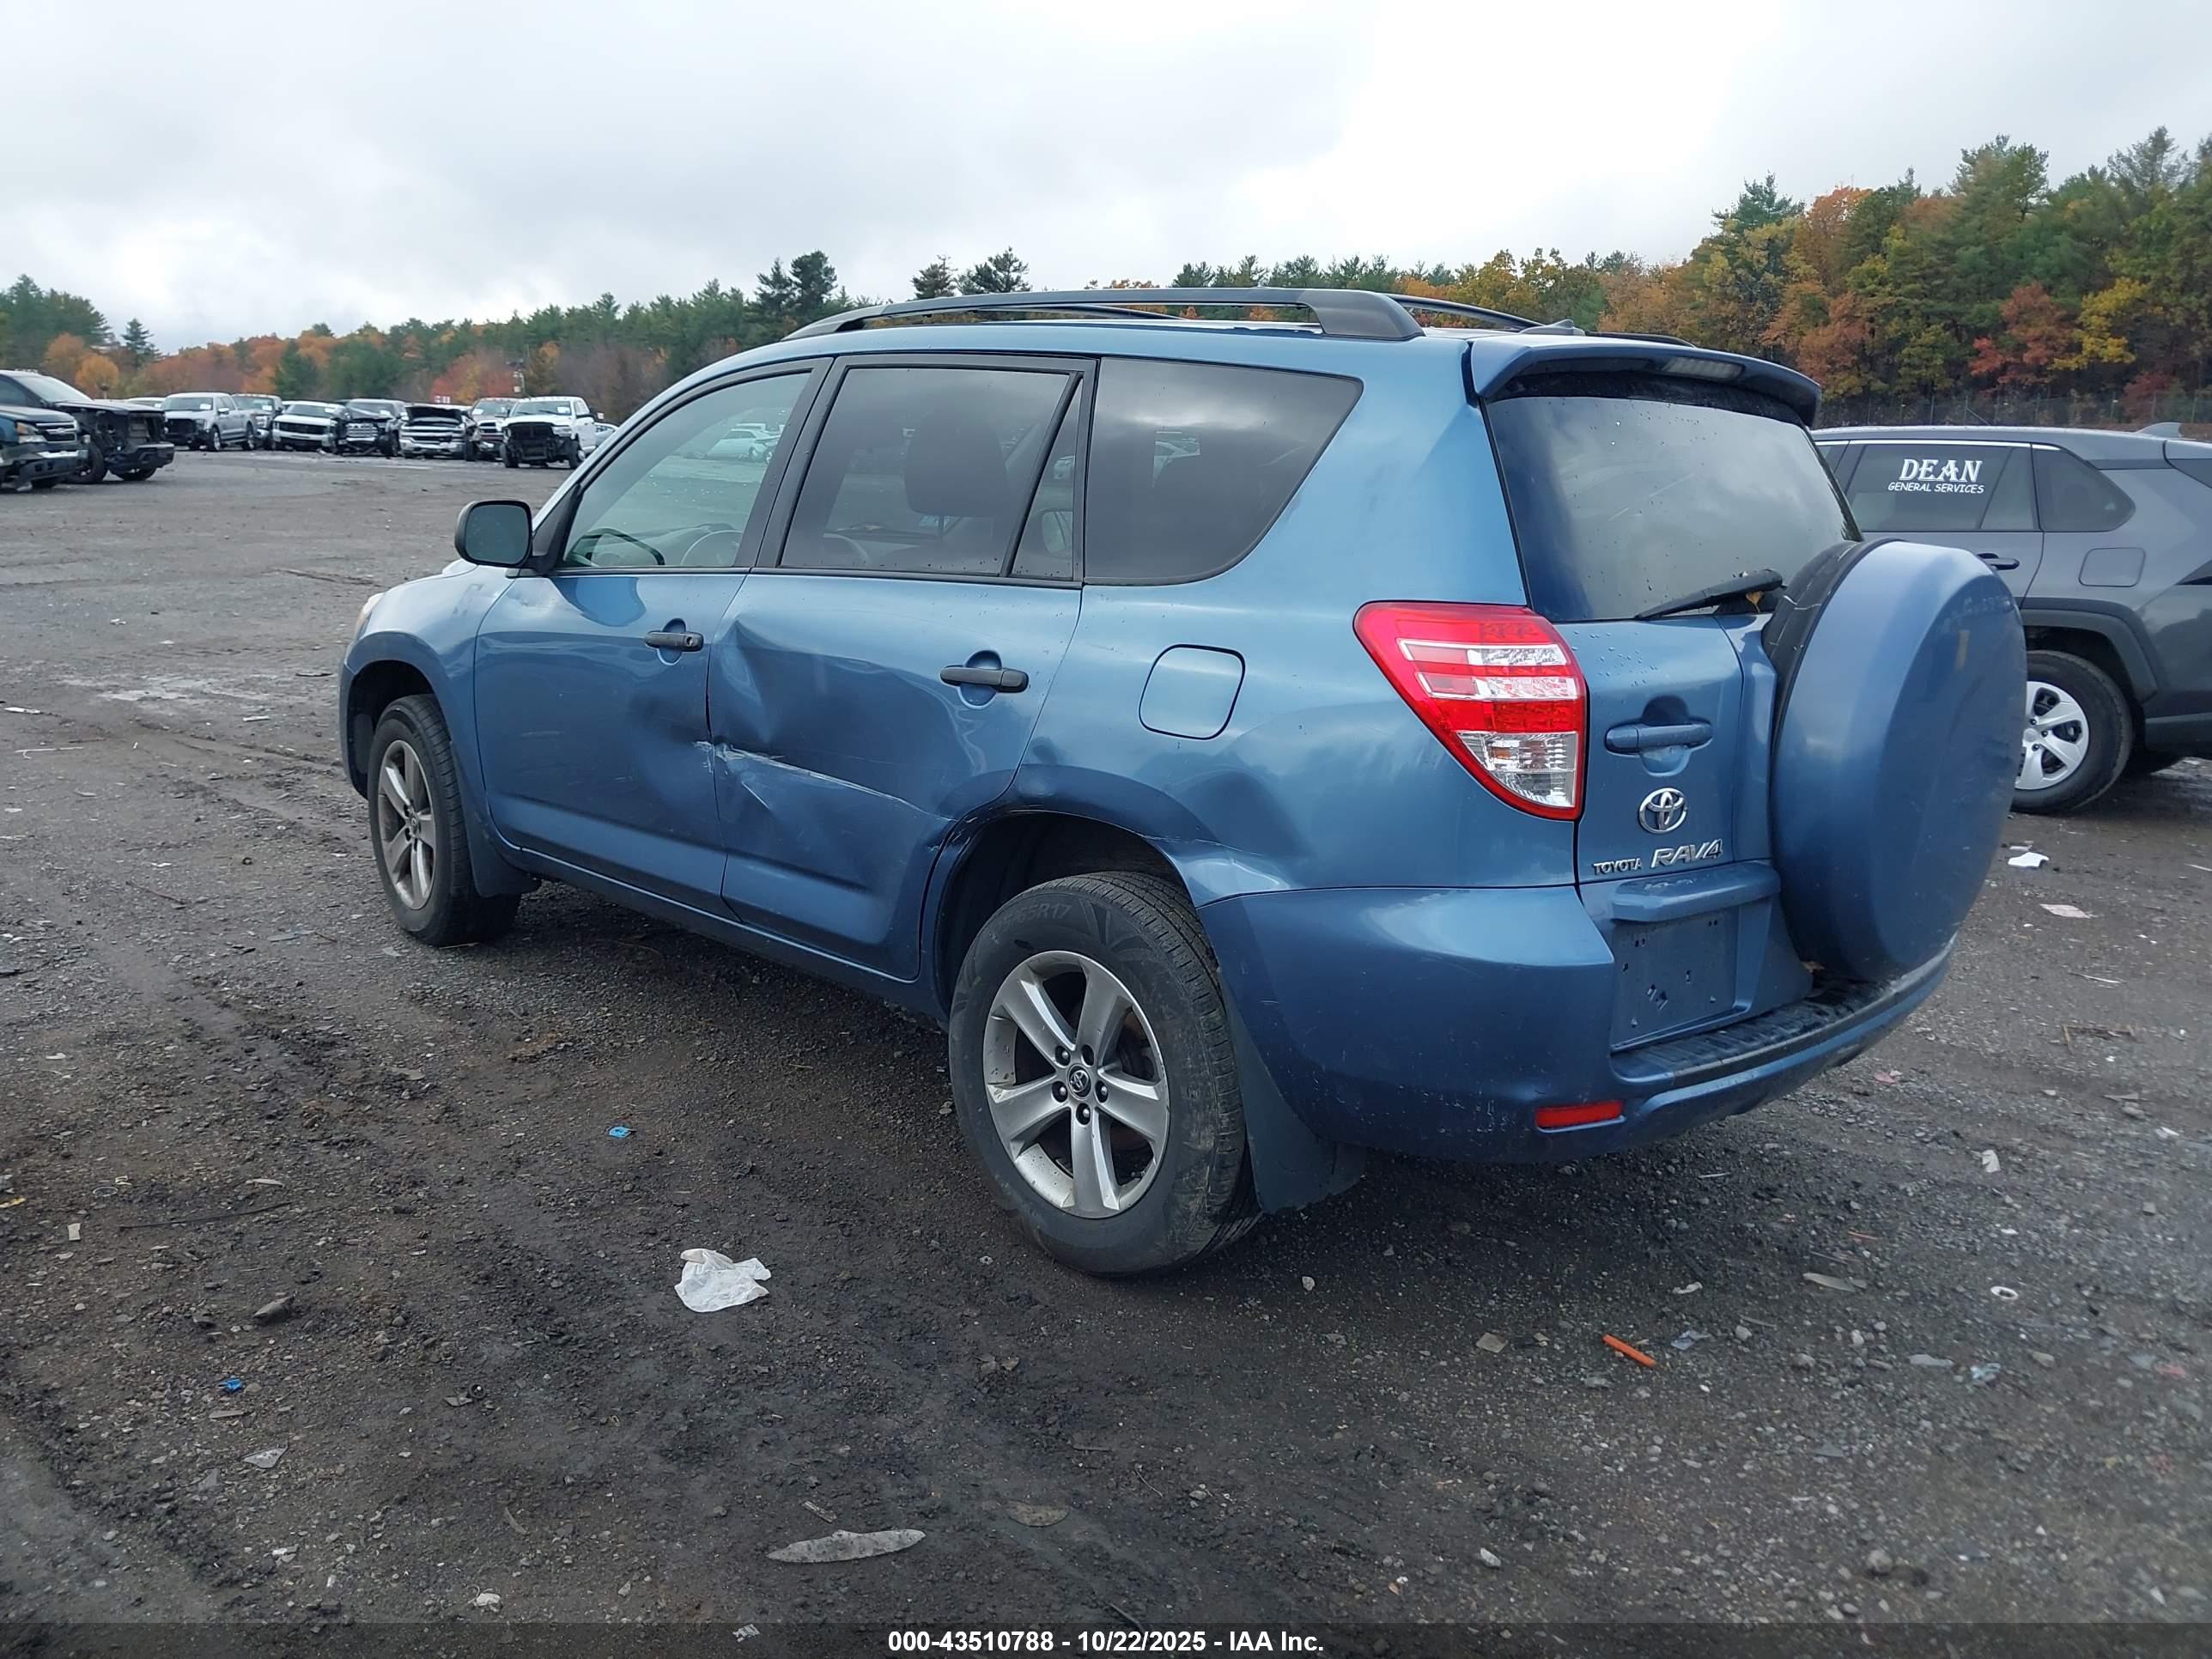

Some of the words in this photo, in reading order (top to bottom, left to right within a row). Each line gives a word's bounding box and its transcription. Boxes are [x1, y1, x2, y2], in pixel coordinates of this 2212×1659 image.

[1899, 458, 1983, 483] DEAN
[1887, 482, 1931, 492] GENERAL
[1934, 483, 1984, 494] SERVICES
[1593, 858, 1642, 874] TOYOTA
[1650, 838, 1723, 868] RAV4
